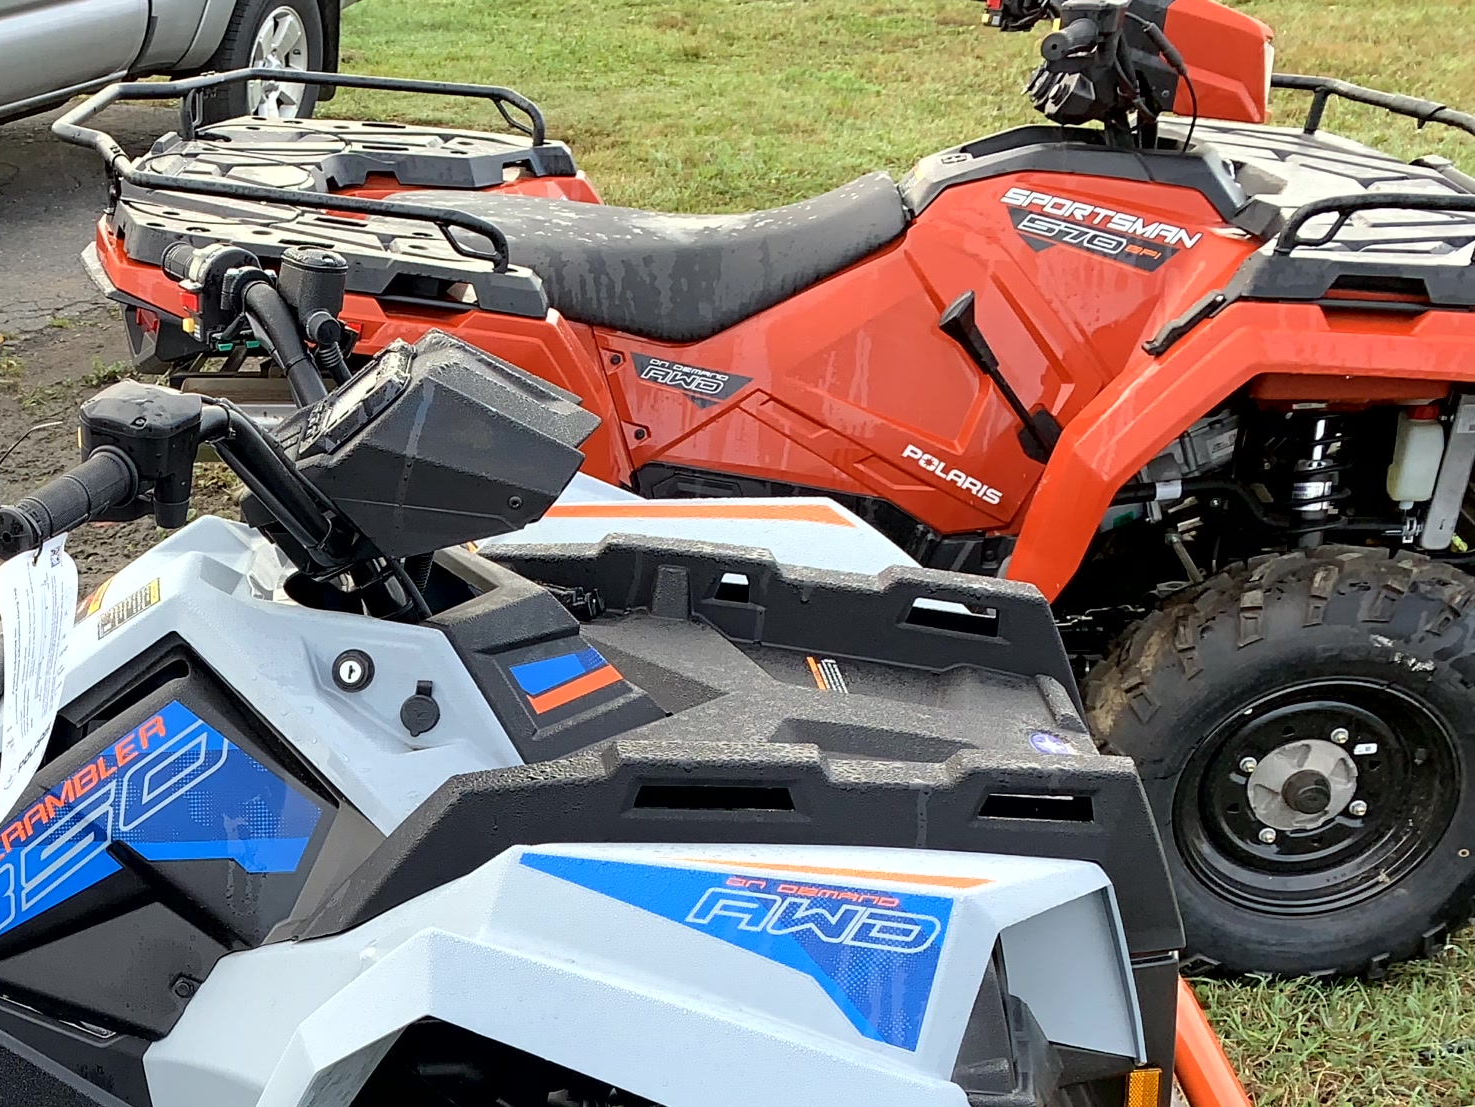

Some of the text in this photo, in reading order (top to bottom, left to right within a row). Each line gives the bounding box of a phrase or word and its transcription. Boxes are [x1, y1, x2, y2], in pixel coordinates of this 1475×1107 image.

[1000, 187, 1203, 249] SPORTSMAN
[1017, 213, 1162, 260] 570 EFI
[641, 365, 724, 394] AWD
[649, 358, 729, 381] ON DEMAND
[901, 443, 1003, 505] POLARIS
[725, 876, 900, 908] ON DEMAND
[685, 886, 942, 954] AWD
